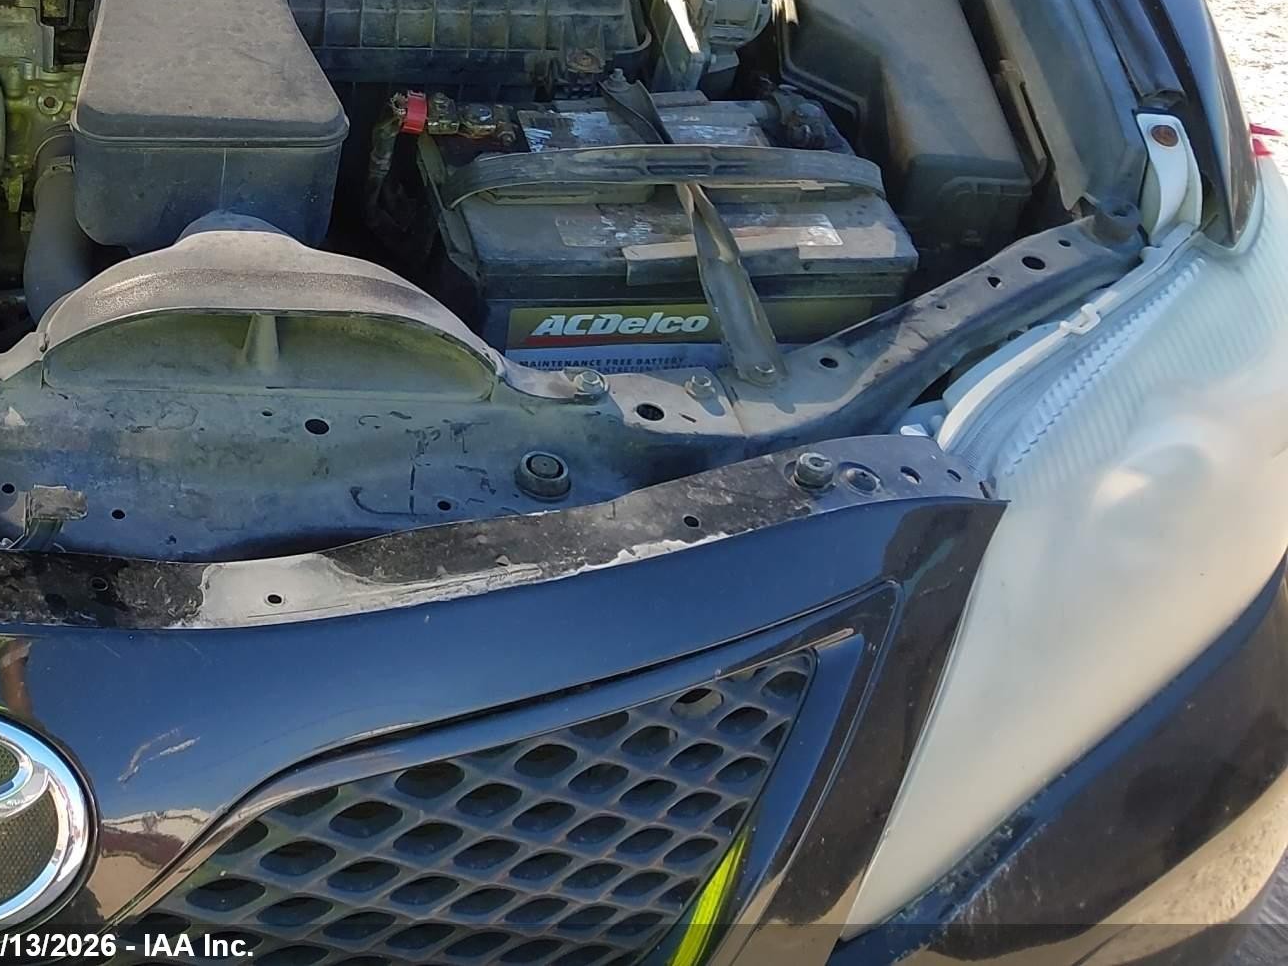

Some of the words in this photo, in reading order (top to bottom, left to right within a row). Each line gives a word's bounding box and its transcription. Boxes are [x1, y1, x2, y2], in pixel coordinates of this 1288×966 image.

[531, 312, 710, 335] ACDelco
[519, 359, 601, 367] MAINTENANCE
[606, 358, 632, 366] FREE
[636, 357, 683, 365] BATTERY
